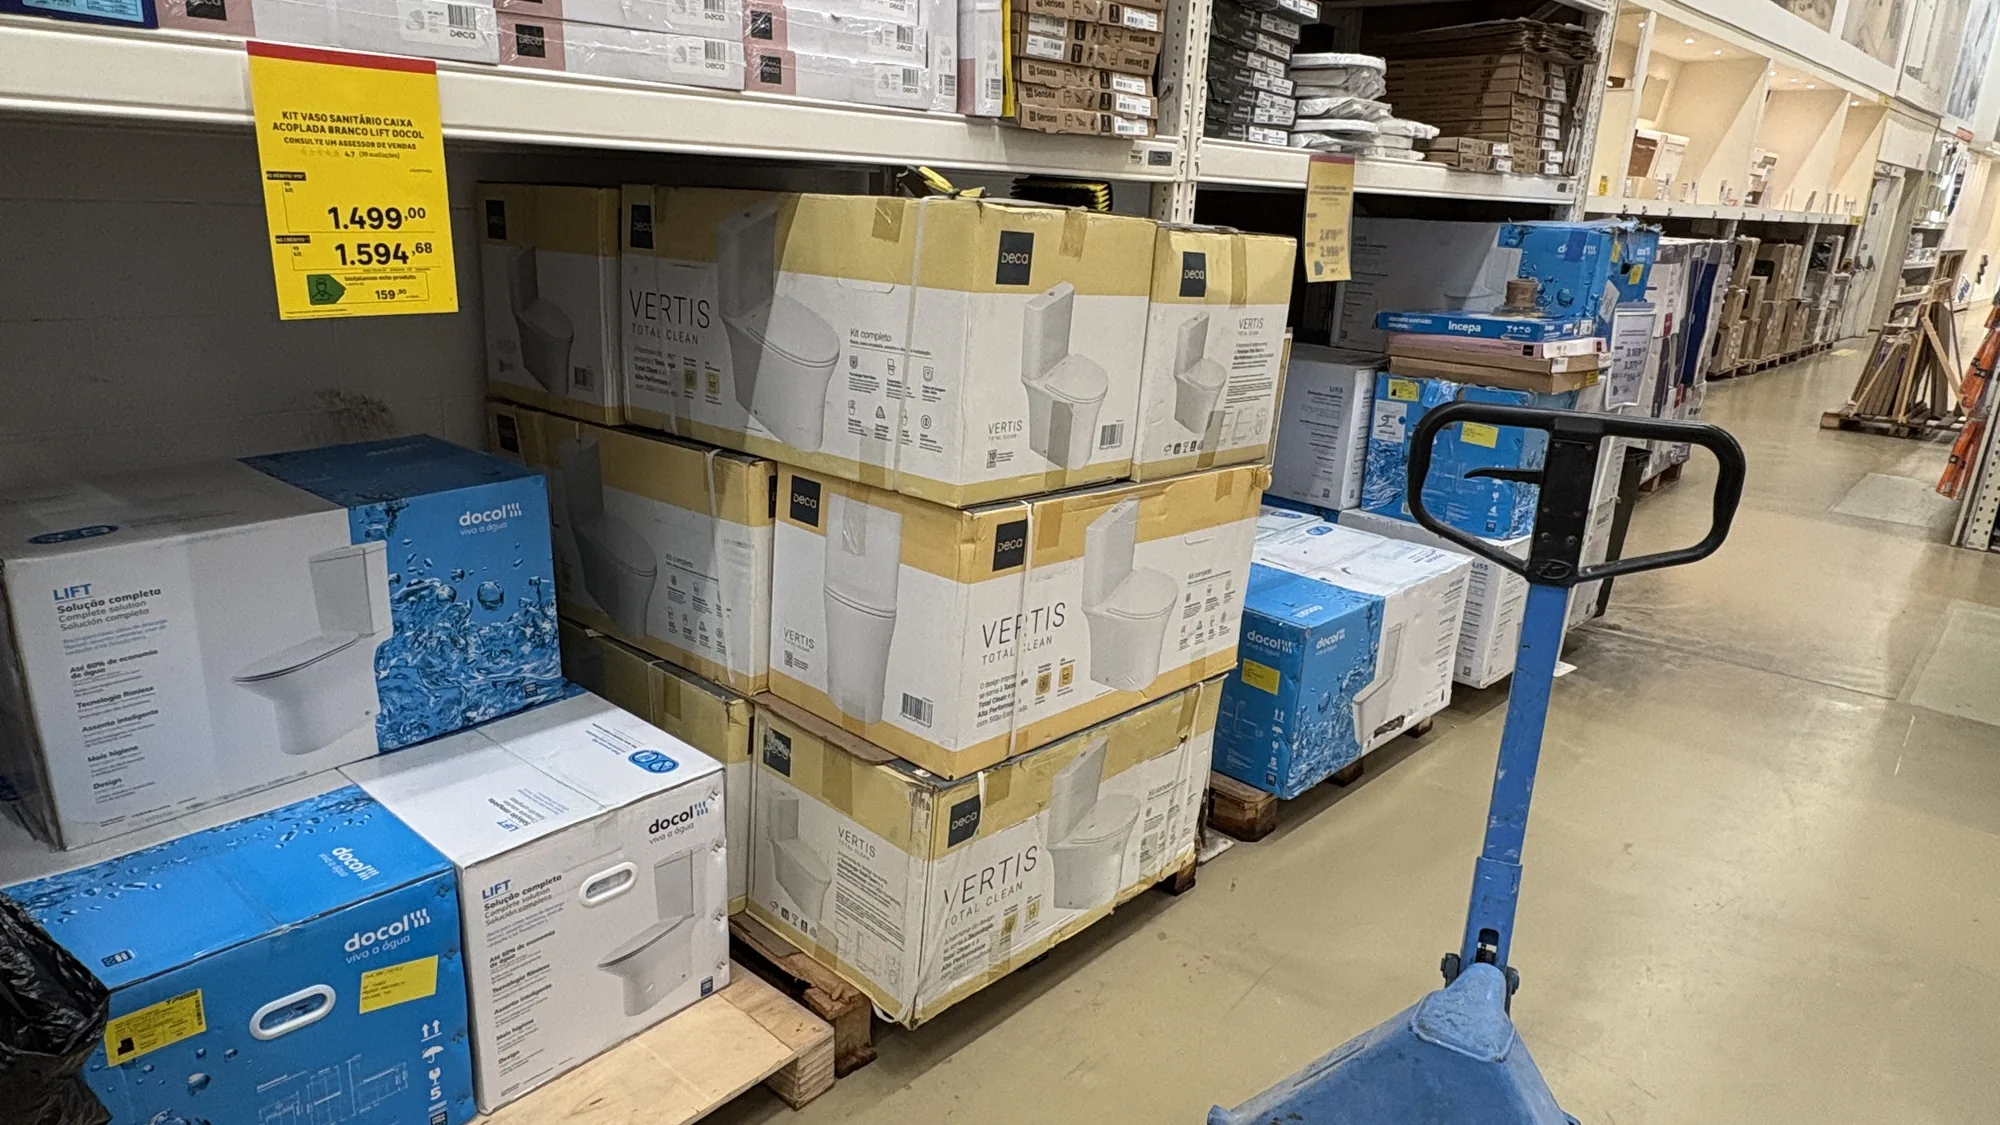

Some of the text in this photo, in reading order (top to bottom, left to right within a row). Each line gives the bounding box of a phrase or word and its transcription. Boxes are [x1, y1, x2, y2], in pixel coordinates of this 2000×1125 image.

[889, 3, 905, 12] Deca
[704, 12, 725, 22] Deca
[449, 29, 476, 40] Deca
[518, 35, 543, 46] Deca
[896, 43, 913, 52] Deca
[705, 62, 725, 71] Deca
[1036, 67, 1057, 78] Sensea
[902, 86, 918, 95] Deca
[1033, 89, 1056, 100] Sensea
[282, 111, 413, 128] KIT VASO SANITÁRIO CAIXA
[1036, 112, 1058, 124] Sensea
[272, 122, 425, 139] ACOPLADA BRANCO LIFT DOCOL
[283, 136, 324, 146] CONSULTE
[325, 139, 338, 147] UM
[338, 140, 376, 149] ASSESSOR
[388, 142, 417, 150] VENDAS
[328, 206, 426, 230] 1.499,00
[1001, 252, 1029, 265] Deca
[1184, 269, 1205, 280] Deca
[629, 289, 711, 329] VERTIS
[1238, 317, 1264, 330] VERTIS
[1448, 320, 1481, 334] Incepa
[631, 322, 699, 345] TOTAL CLEAN
[850, 328, 892, 343] Kit completo
[988, 419, 1023, 435] VERTIS
[793, 492, 817, 509] Deca
[459, 504, 507, 527] docol
[460, 527, 478, 536] viva
[486, 522, 508, 533] água
[997, 537, 1023, 553] Deca
[53, 583, 92, 601] LIFT
[57, 588, 162, 614] Solução completa
[59, 600, 147, 623] Complete solution
[60, 608, 150, 631] Solución completa
[783, 627, 815, 650] VERTIS
[1247, 630, 1281, 650] docol
[1316, 631, 1339, 650] docol
[70, 666, 85, 674] Até
[107, 658, 117, 666] de
[119, 649, 158, 663] economia
[982, 649, 1015, 666] TOTAL
[83, 667, 106, 677] água
[77, 693, 122, 709] Tecnologia
[82, 709, 159, 733] Assento inteligente
[88, 745, 139, 763] Mais higiene
[93, 777, 122, 790] Design
[648, 805, 694, 835] docol
[951, 812, 979, 831] Deca
[649, 822, 694, 845] viva a água
[837, 826, 876, 858] VERTIS
[332, 847, 368, 879] docol
[943, 845, 1038, 912] VERTIS
[482, 878, 511, 900] LIFT
[484, 875, 562, 912] Solução completa
[484, 887, 551, 919] Complete solution
[485, 910, 518, 927] Solución
[518, 894, 552, 913] completa
[944, 881, 1023, 929] TOTAL CLEAN
[344, 914, 410, 953] docol
[345, 934, 411, 965] viva a água
[489, 954, 500, 964] Até
[517, 943, 525, 951] de
[526, 930, 556, 947] economia
[430, 1087, 442, 1100] 5
